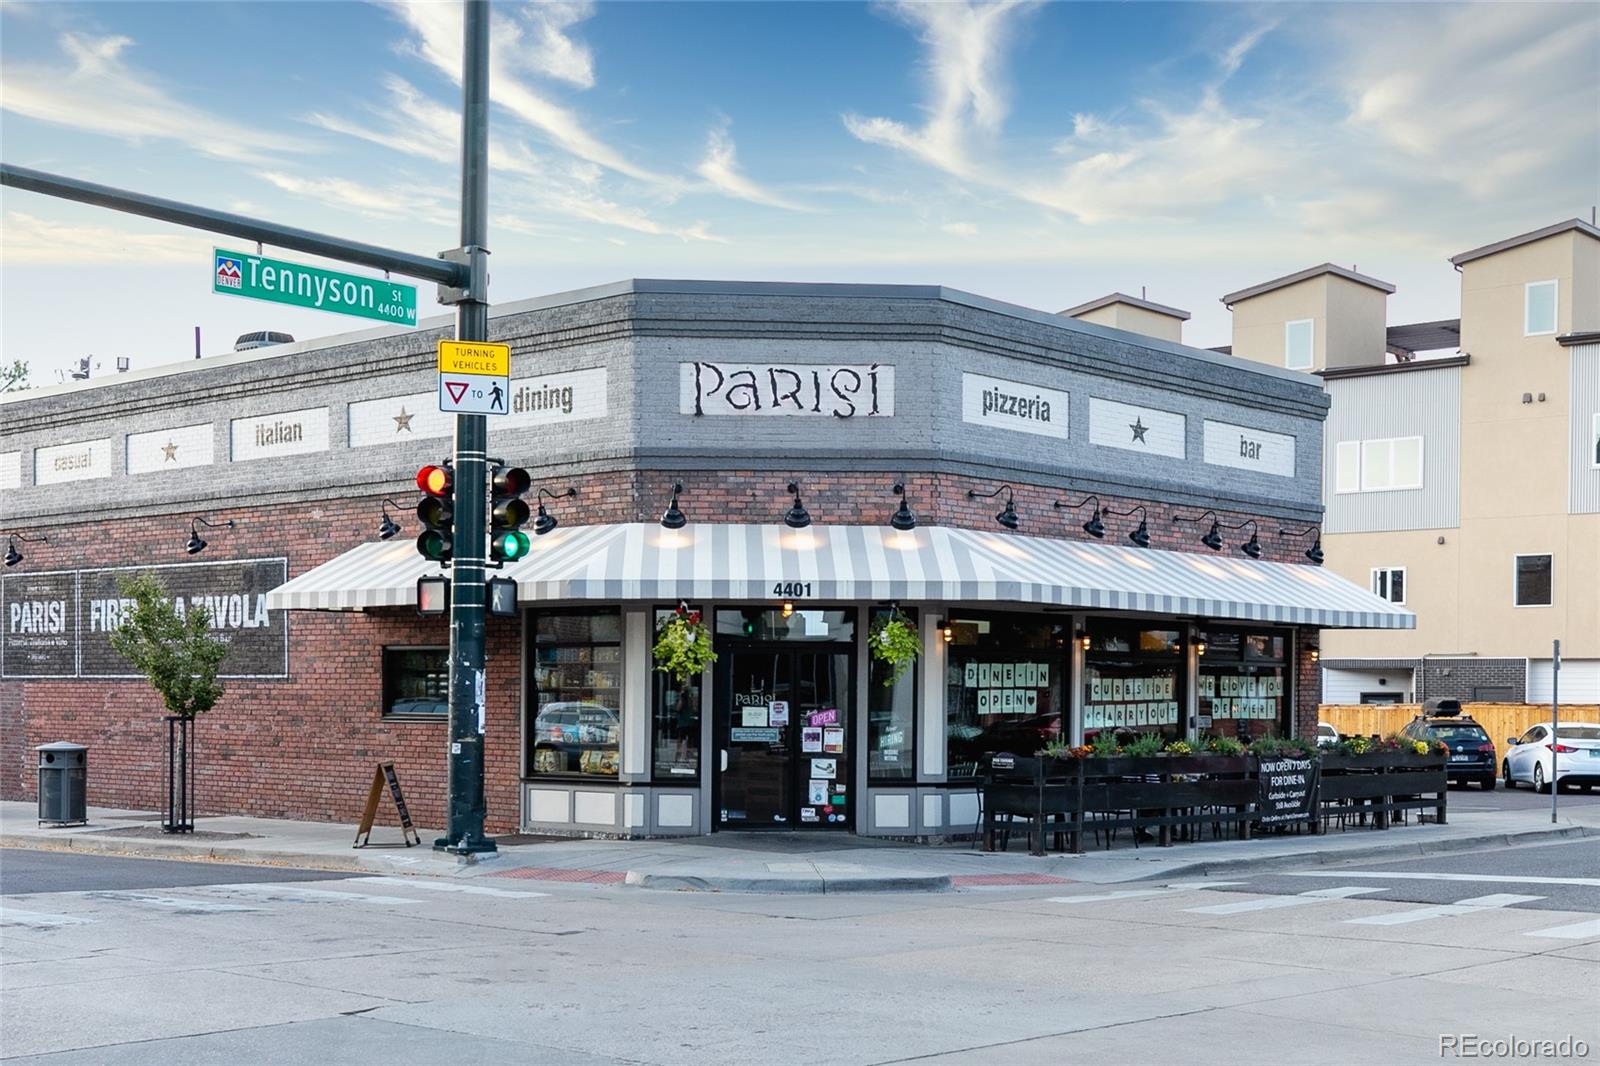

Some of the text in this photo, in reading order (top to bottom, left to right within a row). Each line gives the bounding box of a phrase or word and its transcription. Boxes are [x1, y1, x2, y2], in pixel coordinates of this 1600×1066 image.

[217, 274, 241, 288] DENVER
[247, 258, 374, 308] Tennyson
[391, 289, 402, 302] St
[377, 302, 416, 320] 4400 W
[455, 347, 495, 359] TURNING
[452, 360, 498, 372] VEHICLES
[471, 389, 483, 399] TO
[513, 384, 573, 414] dining
[982, 386, 1051, 422] pizzeria
[255, 420, 303, 447] italian
[1240, 434, 1262, 460] bar
[54, 447, 92, 472] casual
[773, 582, 812, 597] 4401
[10, 600, 66, 634] PARISI
[967, 669, 1047, 682] DINE-IN
[1093, 683, 1170, 696] CURBSIDE
[1222, 682, 1254, 692] LOVE
[980, 694, 1023, 706] OPEN
[811, 709, 837, 726] OPEN
[1261, 763, 1276, 772] NOW
[1276, 762, 1292, 771] OPEN
[1296, 760, 1311, 769] DAYS
[1271, 775, 1305, 786] FOR DINE-IN
